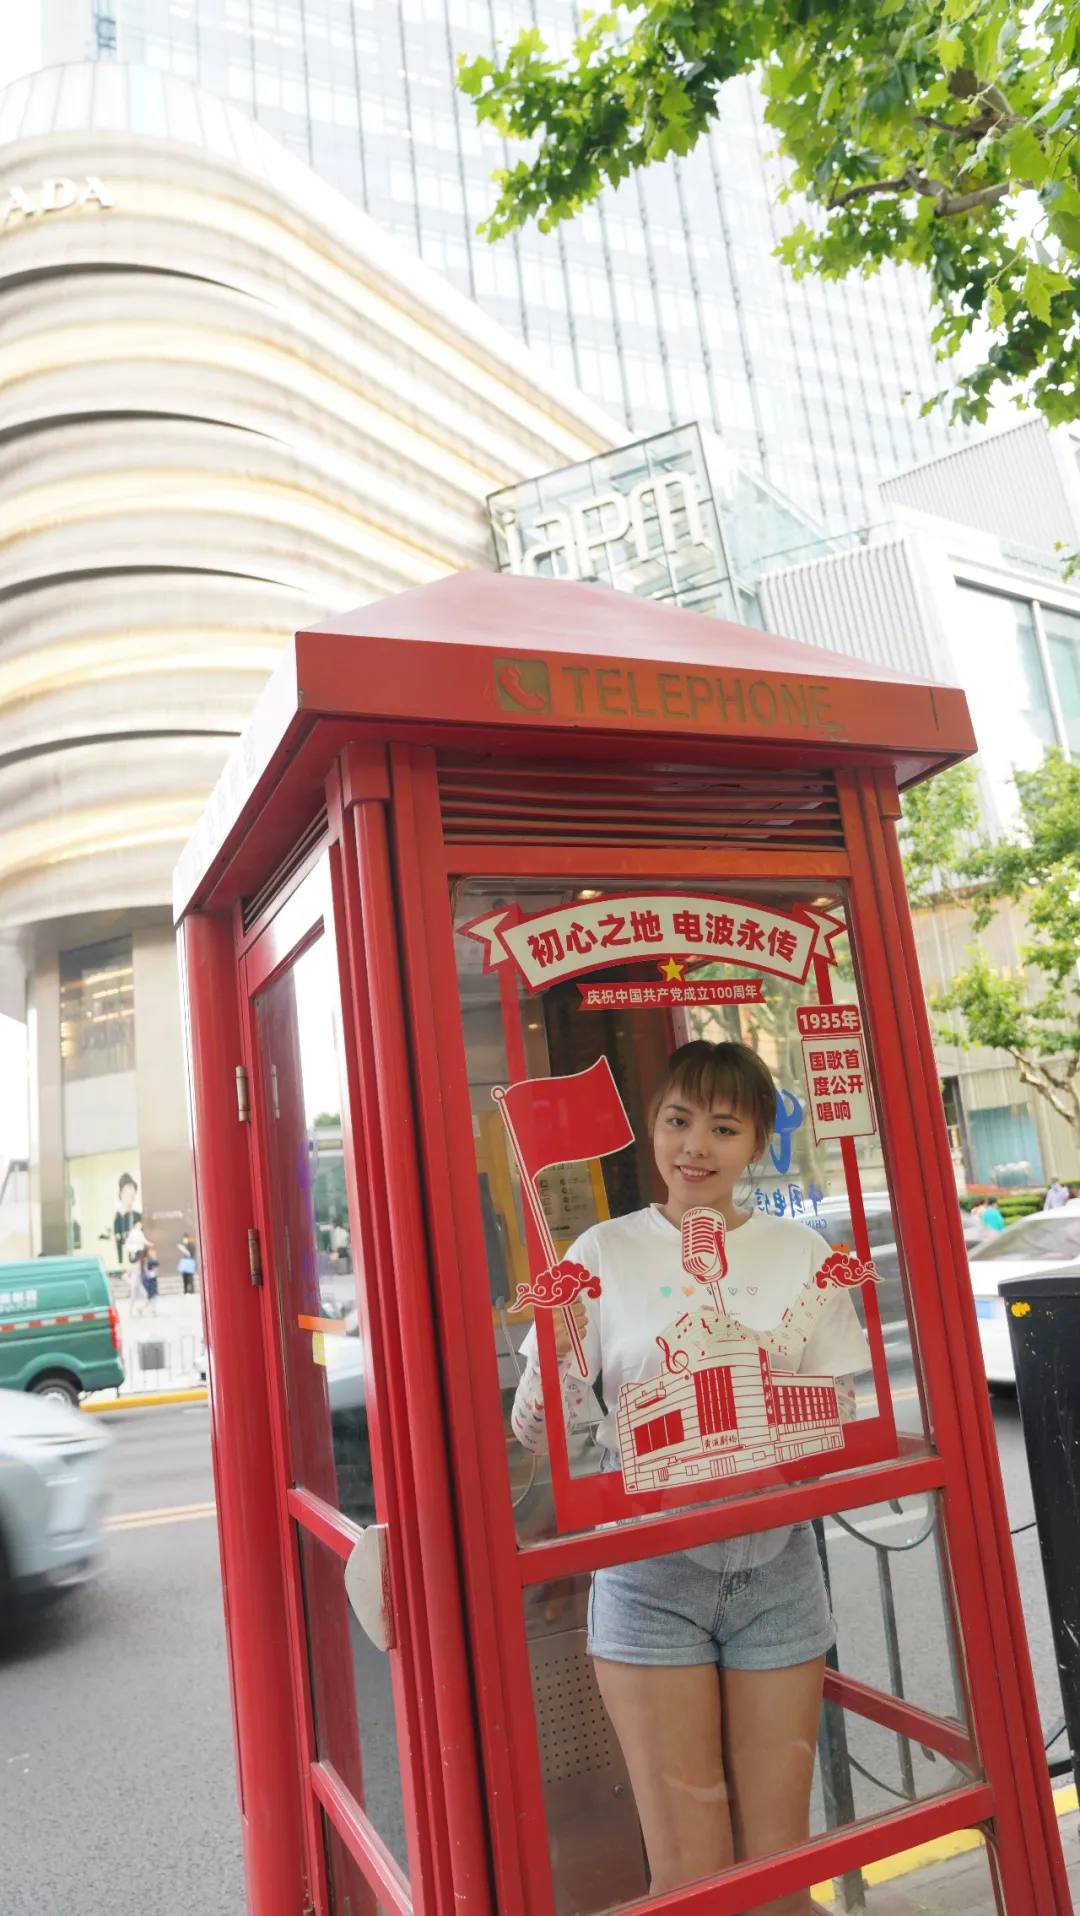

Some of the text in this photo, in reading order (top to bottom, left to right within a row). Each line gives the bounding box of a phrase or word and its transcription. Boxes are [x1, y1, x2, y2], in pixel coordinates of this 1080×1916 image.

[562, 667, 846, 730] TELEPHONE
[527, 910, 798, 968] 初心之地 电波永传
[587, 984, 758, 1005] 庆祝中国共产党成立100周年
[800, 1010, 859, 1030] 1935年
[809, 1049, 859, 1071] 国歌首
[813, 1075, 863, 1097] 度公开
[816, 1100, 851, 1122] 唱响
